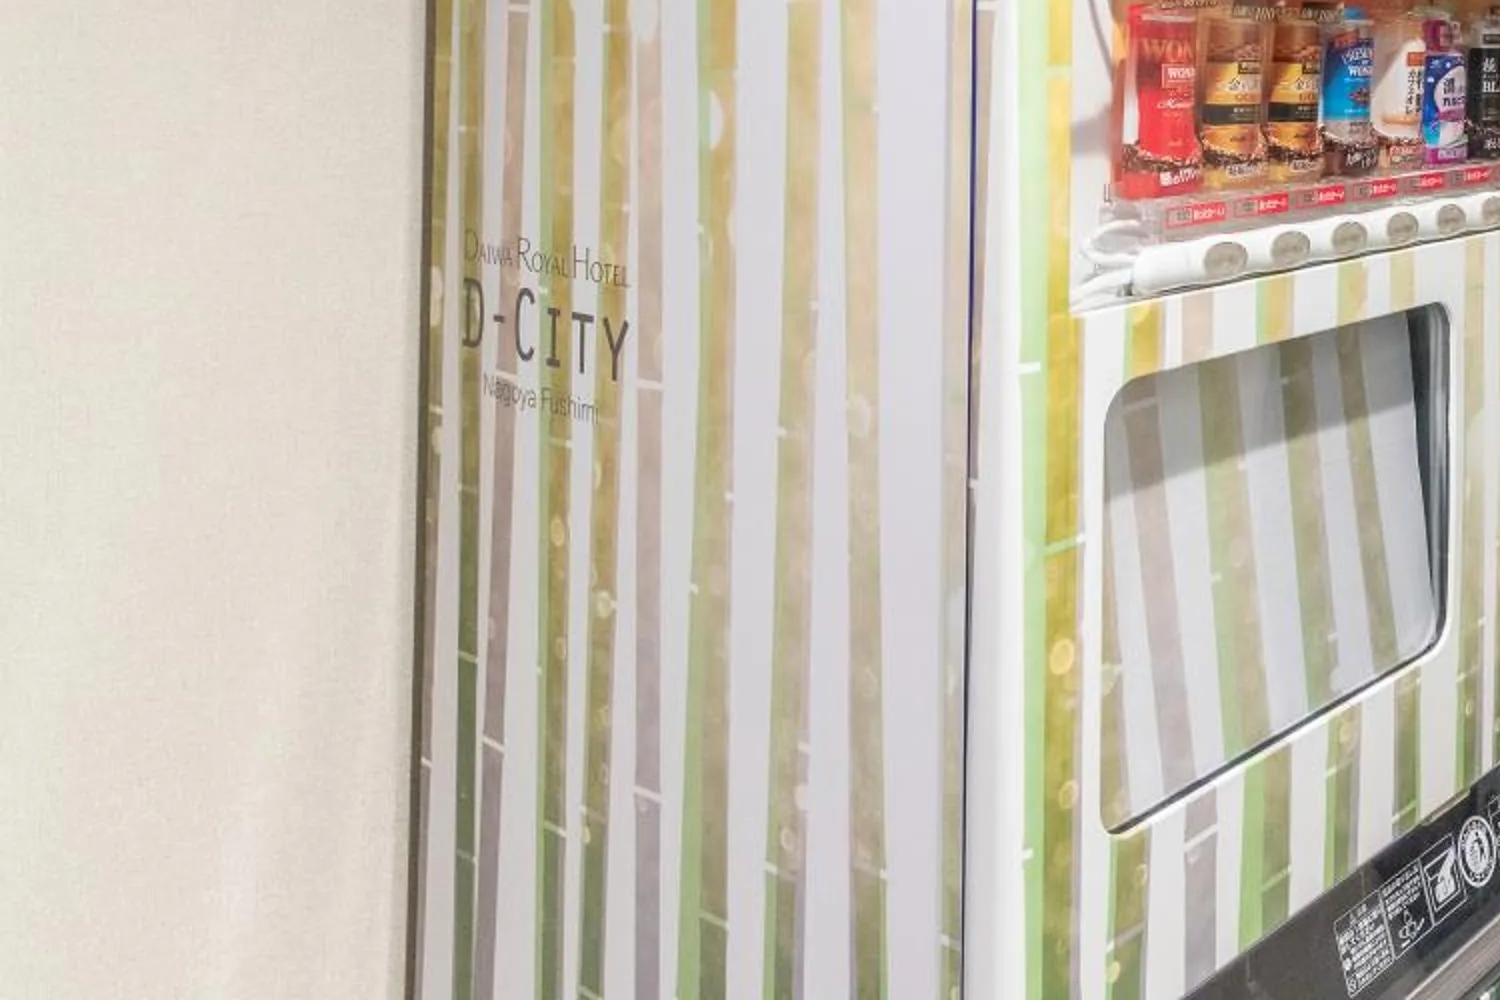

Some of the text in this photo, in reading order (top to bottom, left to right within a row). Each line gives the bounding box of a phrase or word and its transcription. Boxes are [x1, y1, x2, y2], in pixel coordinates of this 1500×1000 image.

[517, 237, 569, 278] ROYAL
[572, 246, 632, 288] HOTEL
[462, 277, 629, 382] D-CITY
[483, 373, 599, 425] Nagoya Fushimi
